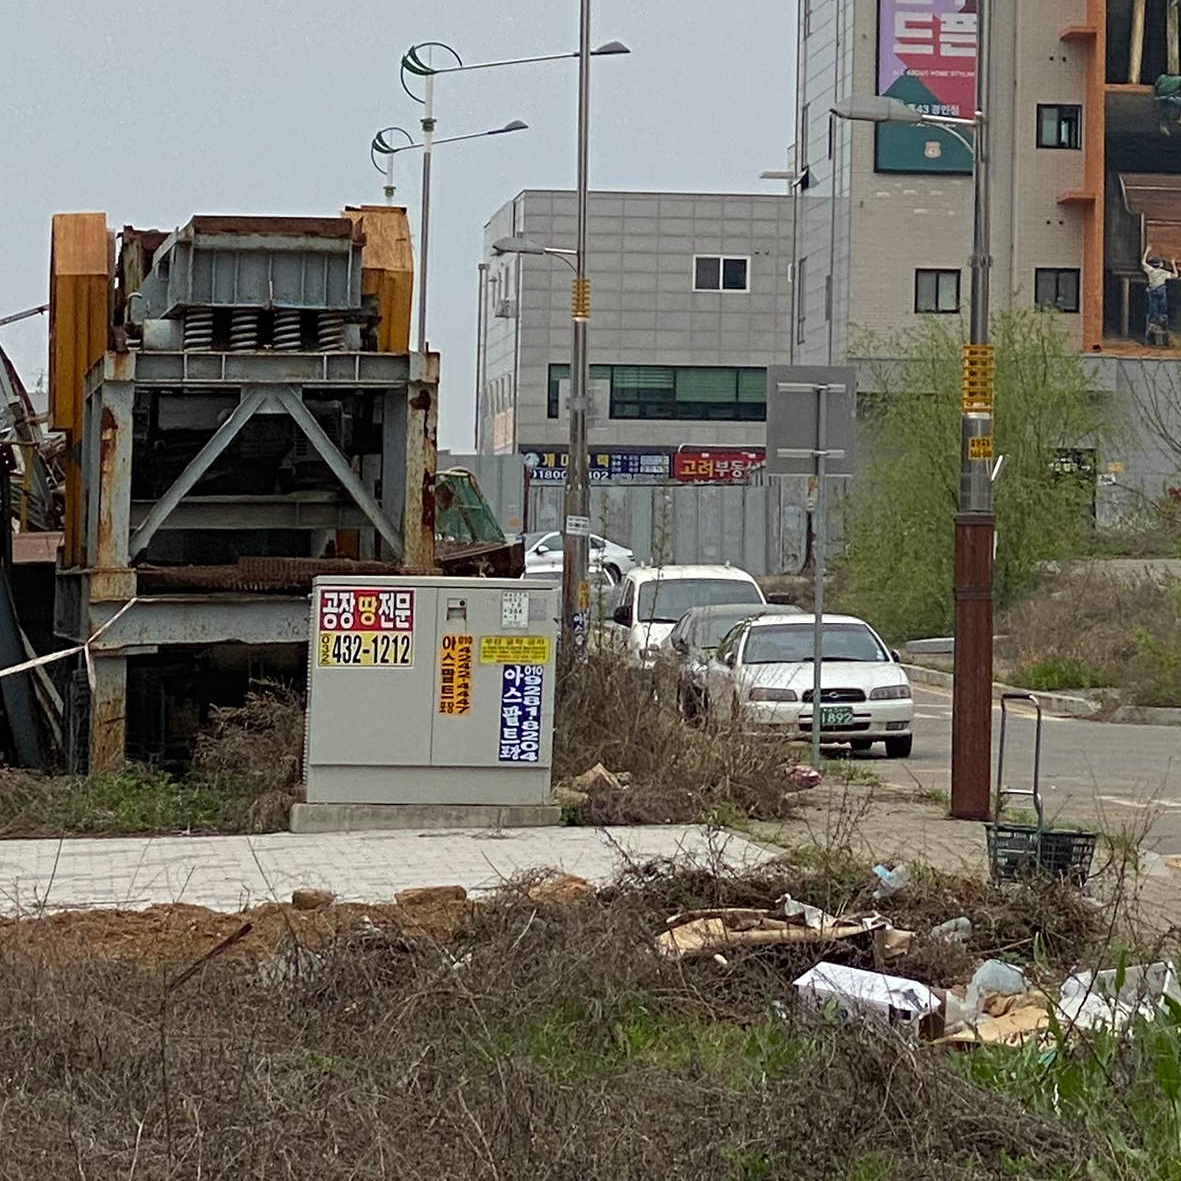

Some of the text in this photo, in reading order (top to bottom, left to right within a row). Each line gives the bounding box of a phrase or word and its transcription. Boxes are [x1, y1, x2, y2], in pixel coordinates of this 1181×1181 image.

[322, 592, 411, 629] 공장 땅 전문
[332, 635, 410, 664] 432-1212
[458, 636, 473, 645] 010
[524, 665, 543, 675] 010
[500, 666, 524, 744] 아스팔트
